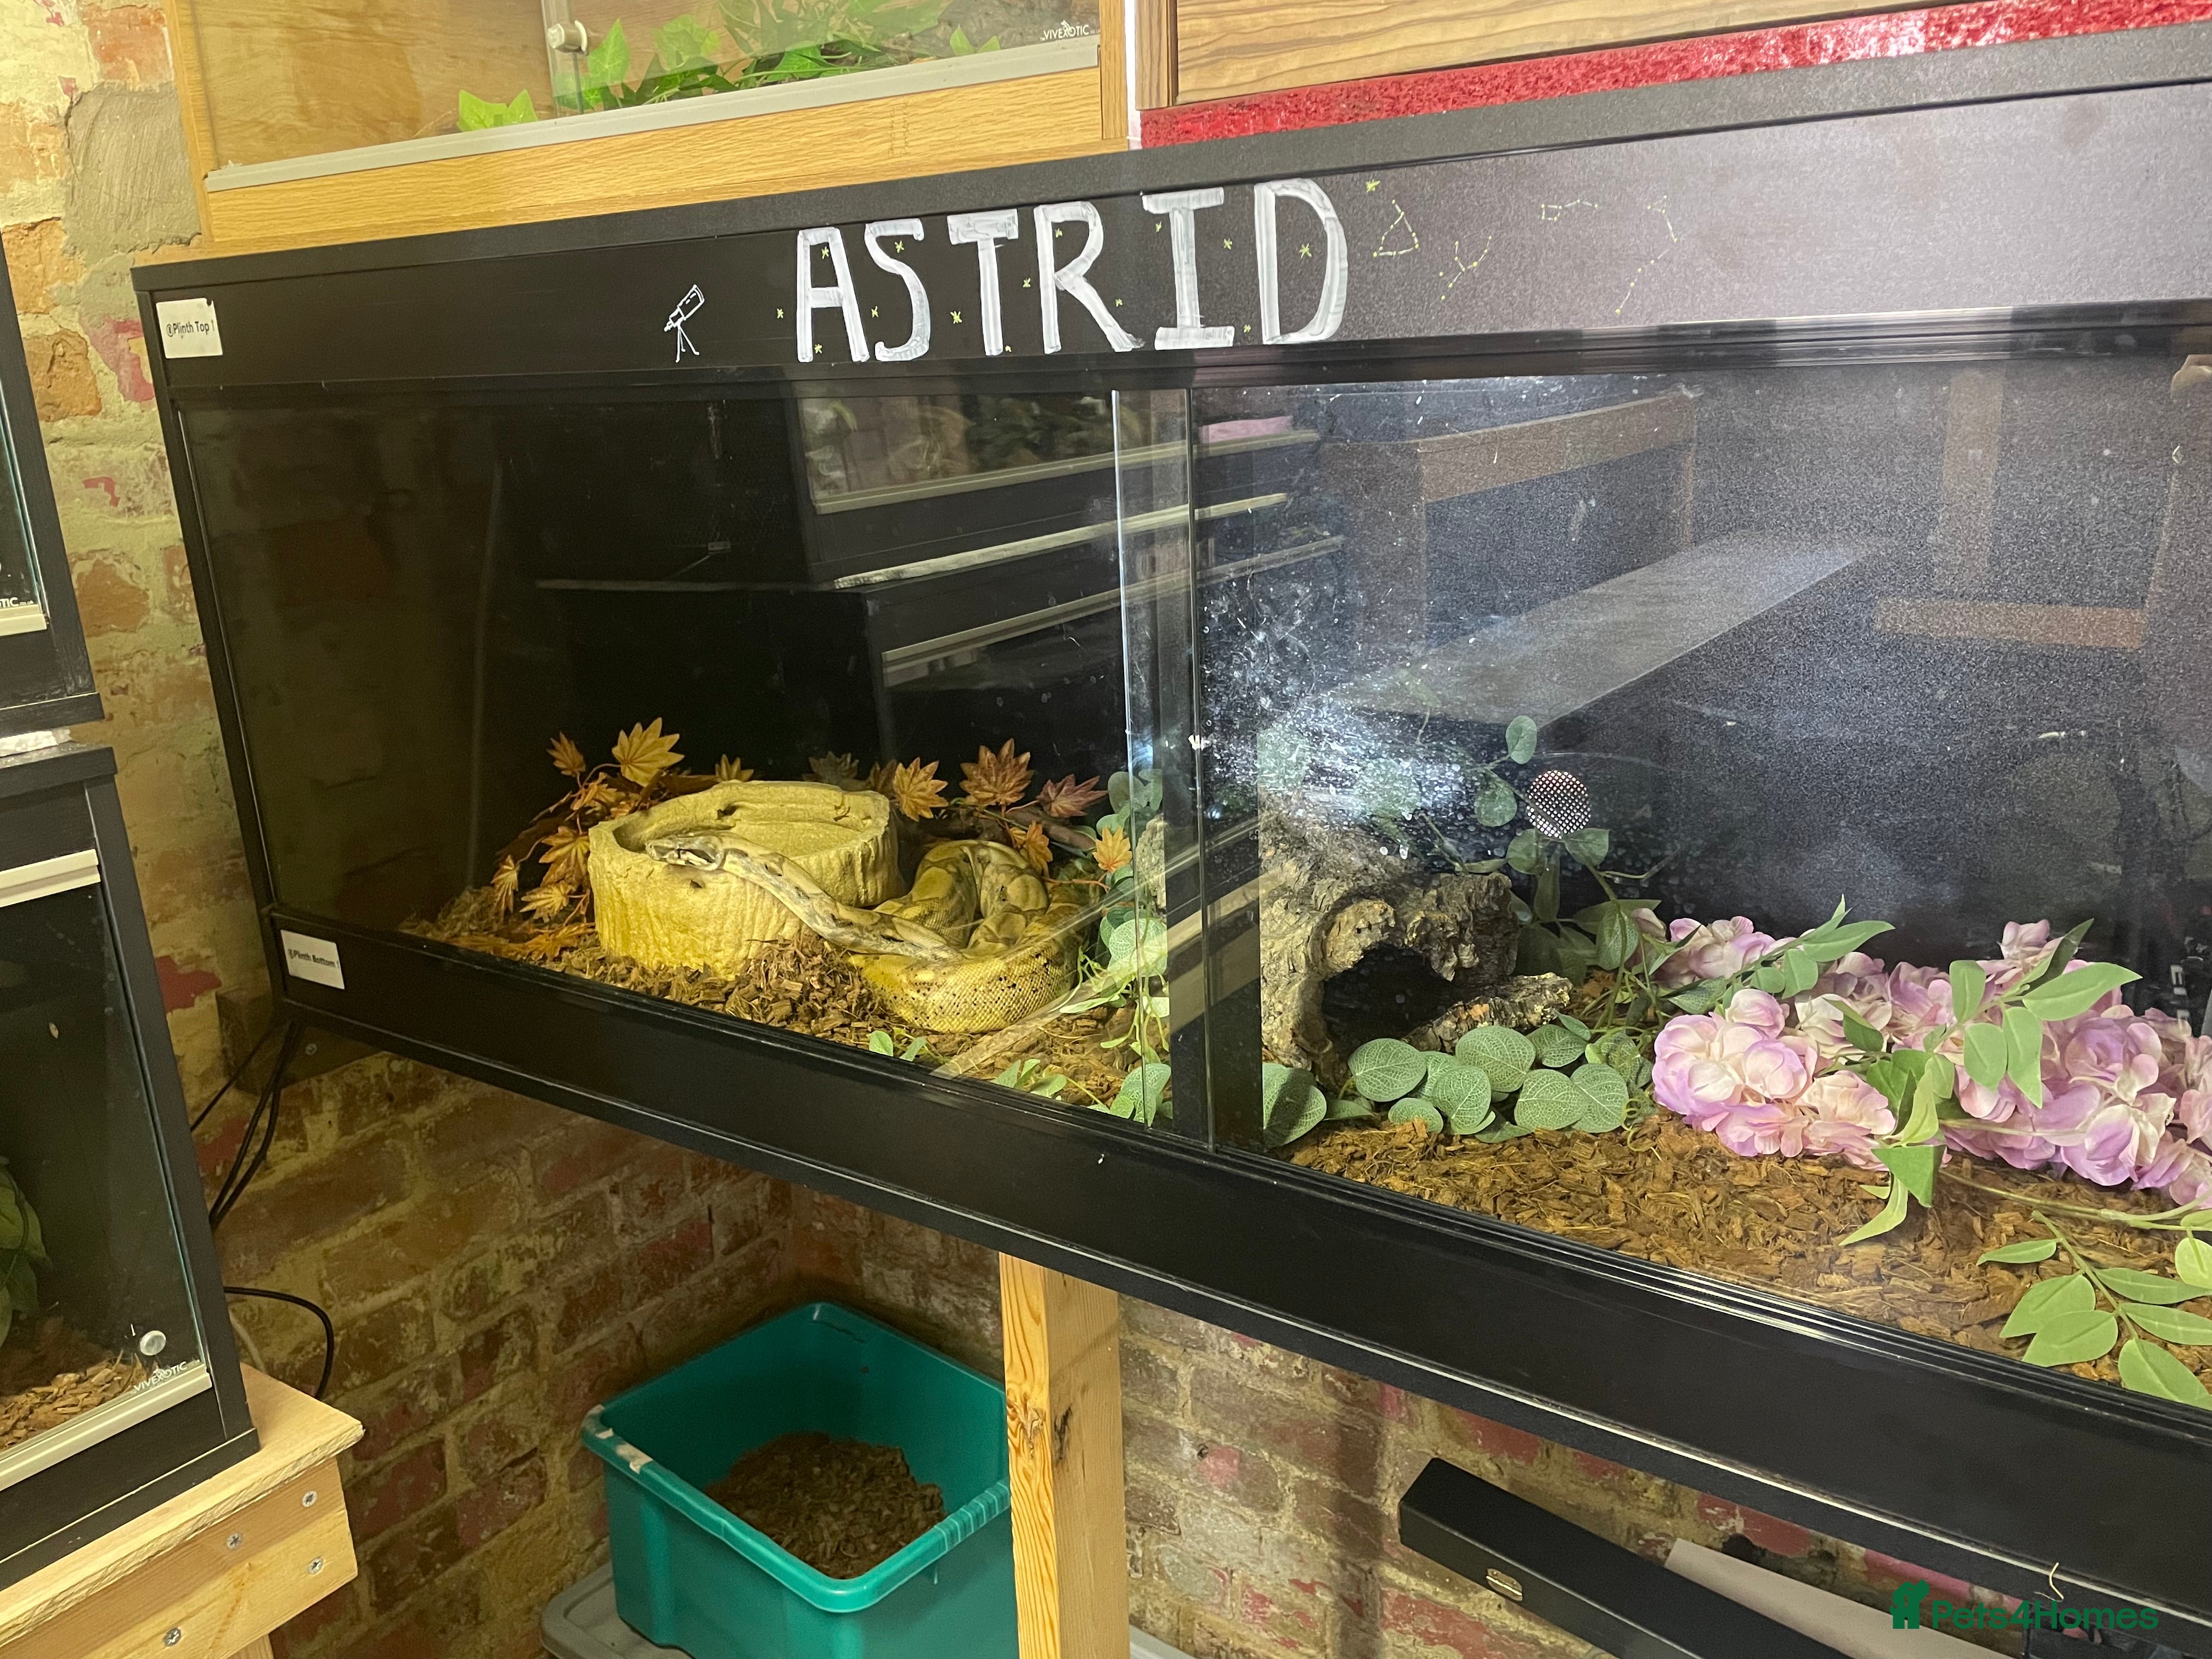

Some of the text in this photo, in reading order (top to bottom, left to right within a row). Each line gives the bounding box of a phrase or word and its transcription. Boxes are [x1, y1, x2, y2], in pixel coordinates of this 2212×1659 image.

[1043, 24, 1089, 40] VIVEXOTIC
[796, 177, 1348, 363] ASTRID
[195, 321, 210, 335] Top
[133, 1361, 187, 1392] VIVEXOTIC
